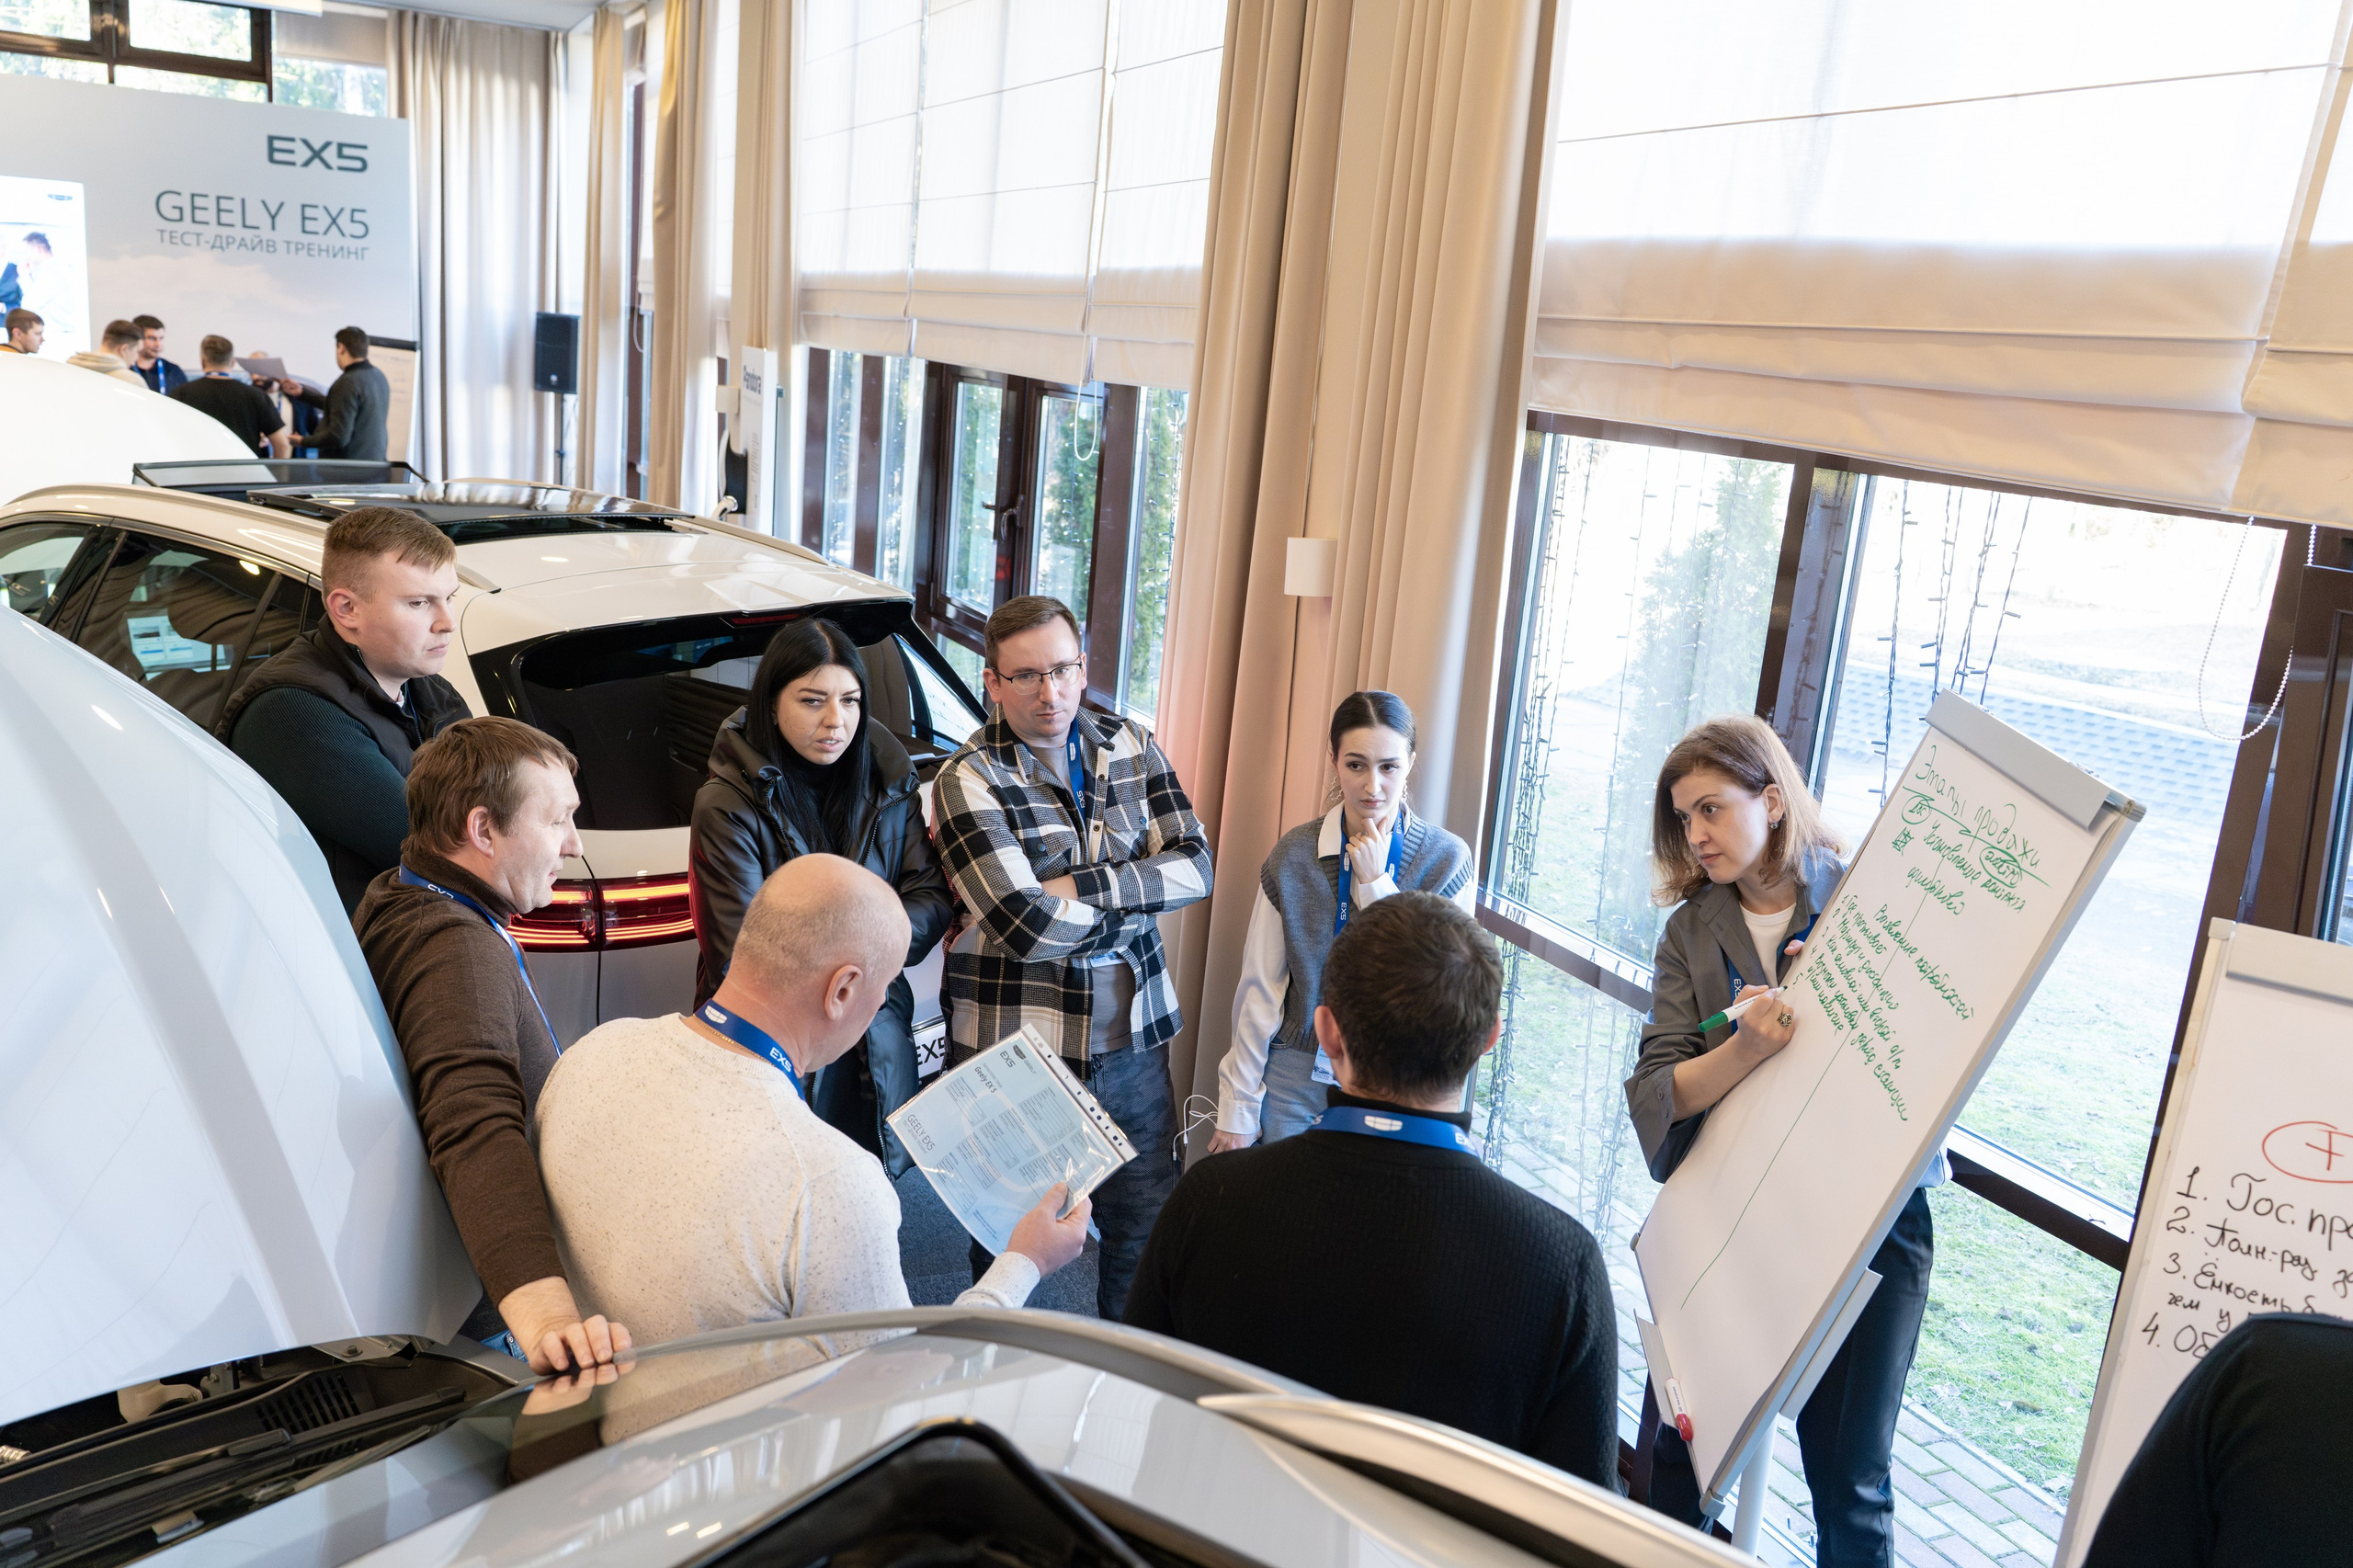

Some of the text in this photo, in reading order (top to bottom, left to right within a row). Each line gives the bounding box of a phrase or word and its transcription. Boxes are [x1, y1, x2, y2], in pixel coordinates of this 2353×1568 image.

[267, 134, 368, 173] EX5
[154, 189, 369, 239] GEELY EX5
[155, 228, 370, 261] ТЕСТ-ДРАЙВ ТРЕНИНГ
[1076, 790, 1086, 809] EX5
[1915, 744, 2040, 869] Этапы продажи
[769, 1046, 792, 1073] EX5
[999, 1050, 1017, 1068] EX5
[974, 1066, 988, 1083] Geely
[984, 1080, 995, 1090] EX
[907, 1114, 936, 1151] GEELY EX5
[2177, 1166, 2208, 1200] 1.
[2166, 1206, 2195, 1234] 2.
[2163, 1253, 2186, 1280] 3.
[2142, 1312, 2160, 1347] 4.
[2216, 1309, 2231, 1334] у
